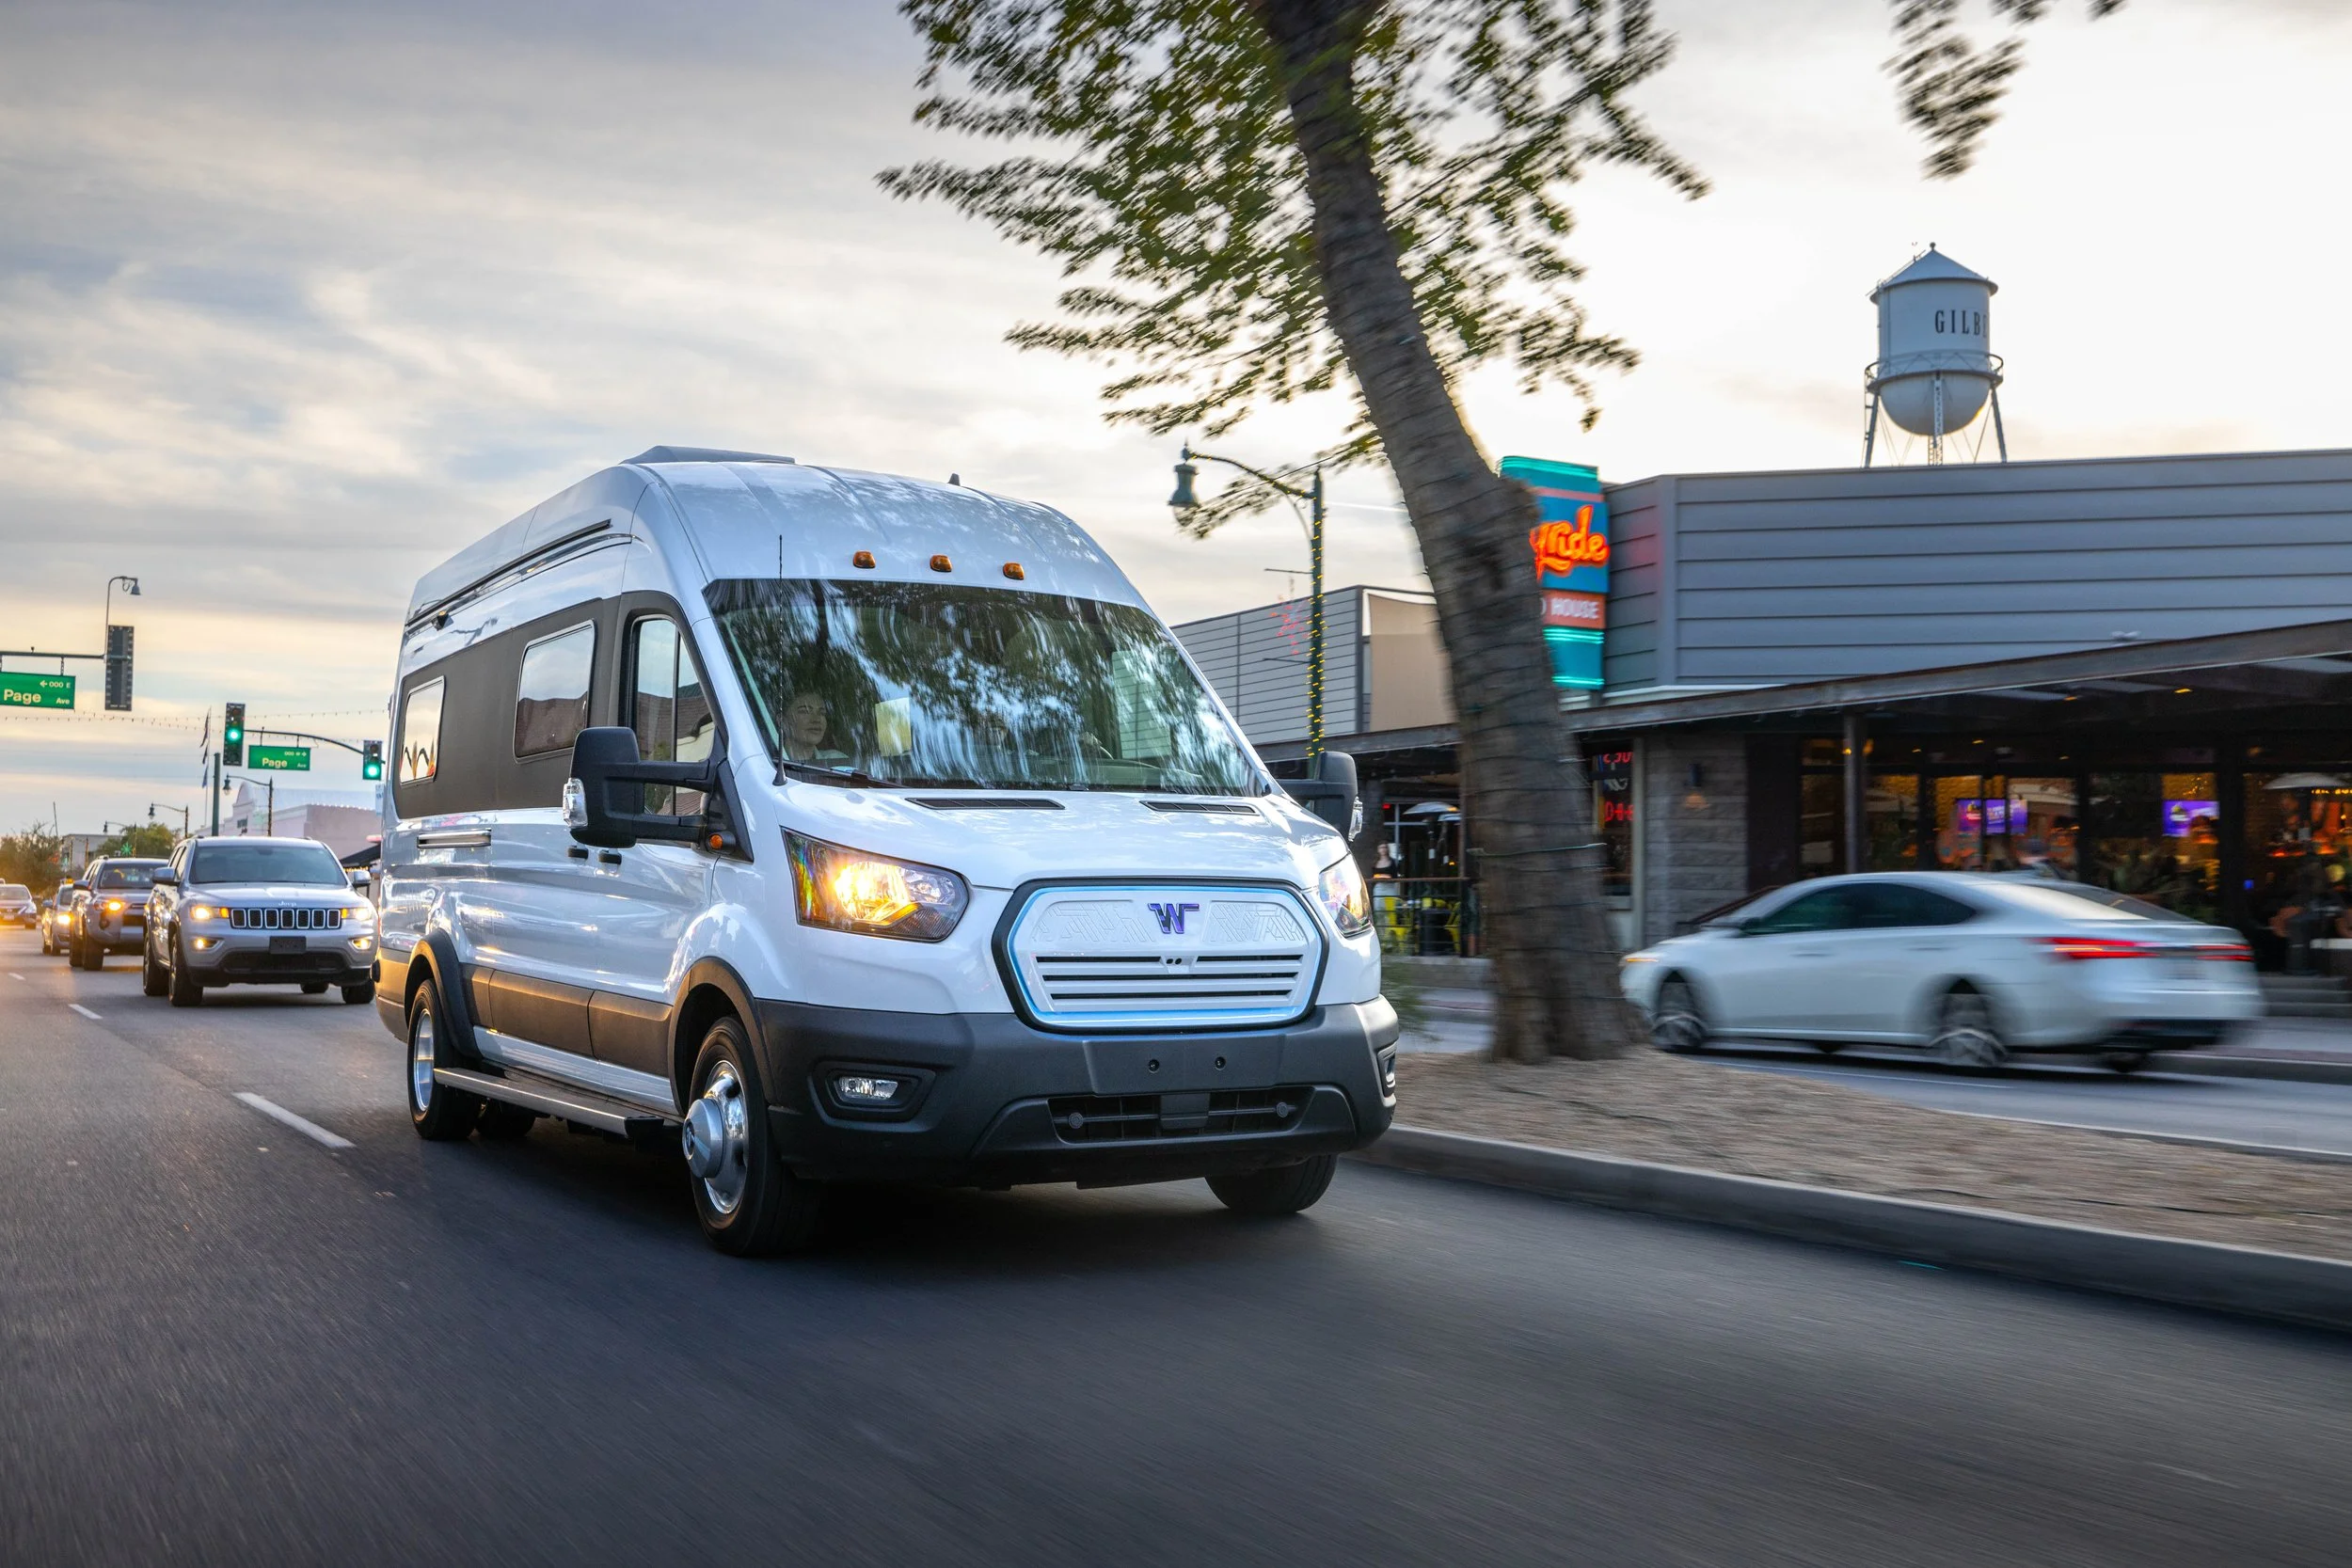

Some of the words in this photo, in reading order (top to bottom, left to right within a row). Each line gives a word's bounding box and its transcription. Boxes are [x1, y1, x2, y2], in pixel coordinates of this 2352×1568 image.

[1550, 597, 1599, 620] HOUSE
[4, 689, 41, 705] Page
[262, 757, 288, 768] Page
